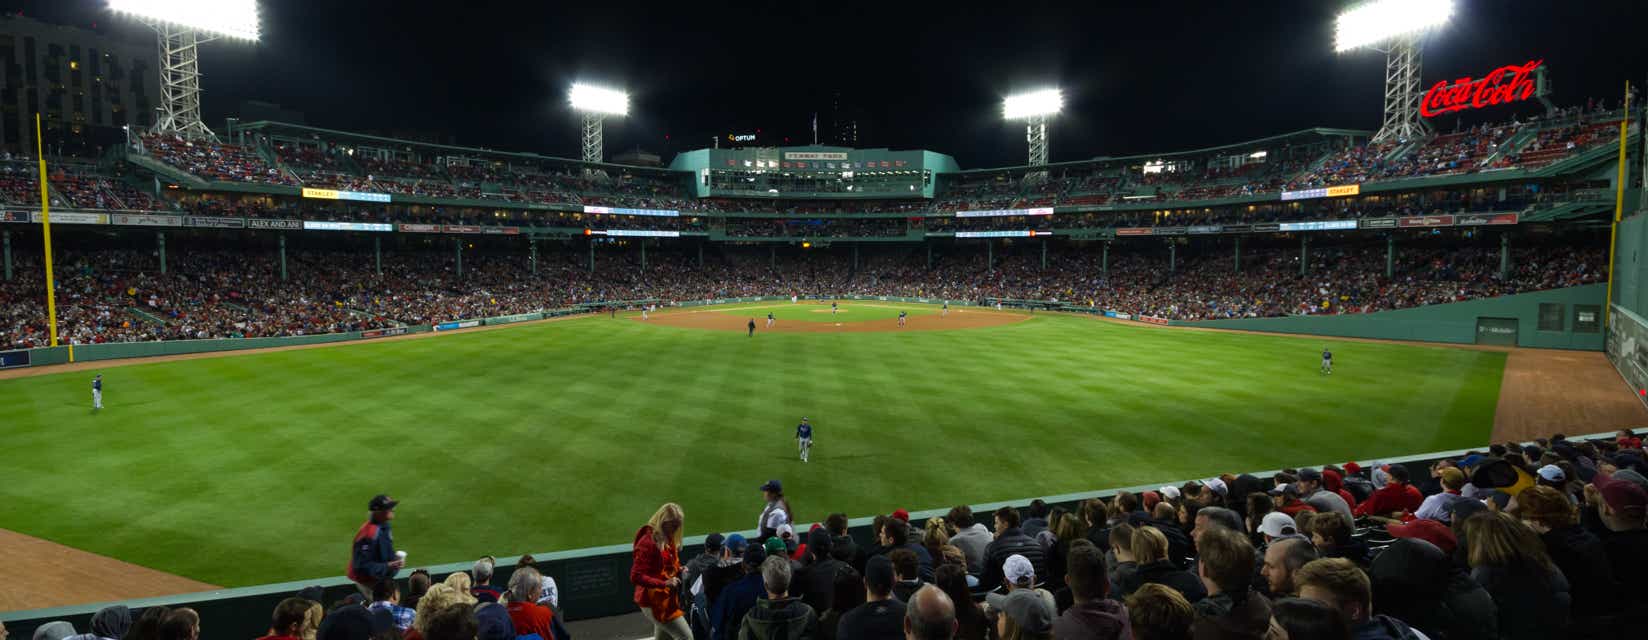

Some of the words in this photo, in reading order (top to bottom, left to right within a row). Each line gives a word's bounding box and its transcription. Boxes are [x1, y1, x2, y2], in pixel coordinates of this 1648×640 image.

[735, 134, 756, 142] OPTUM
[1329, 186, 1354, 194] STANLEY
[251, 220, 270, 228] ALEX
[270, 220, 287, 228] AND
